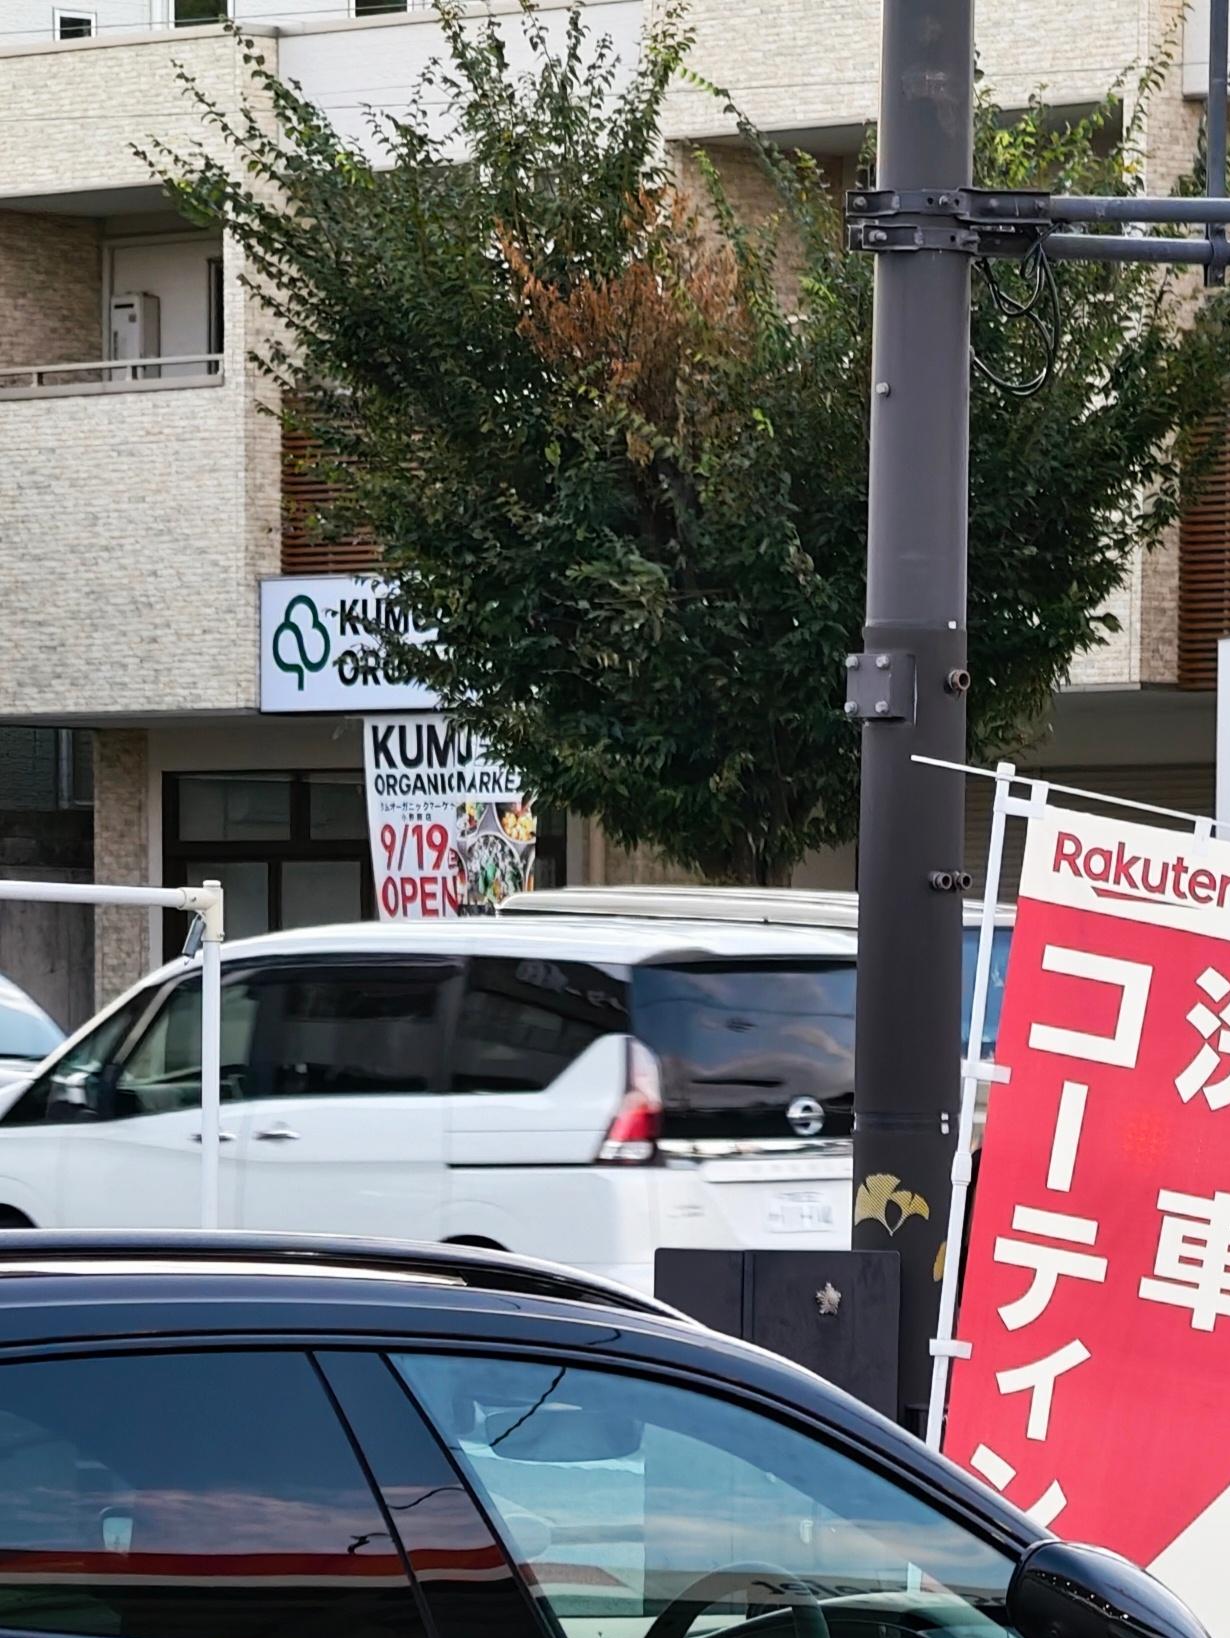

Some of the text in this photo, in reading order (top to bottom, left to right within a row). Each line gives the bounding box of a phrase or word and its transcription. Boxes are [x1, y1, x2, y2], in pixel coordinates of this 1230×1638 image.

[456, 770, 522, 793] MARKE
[380, 823, 449, 871] 9/19
[382, 876, 460, 918] OPEN
